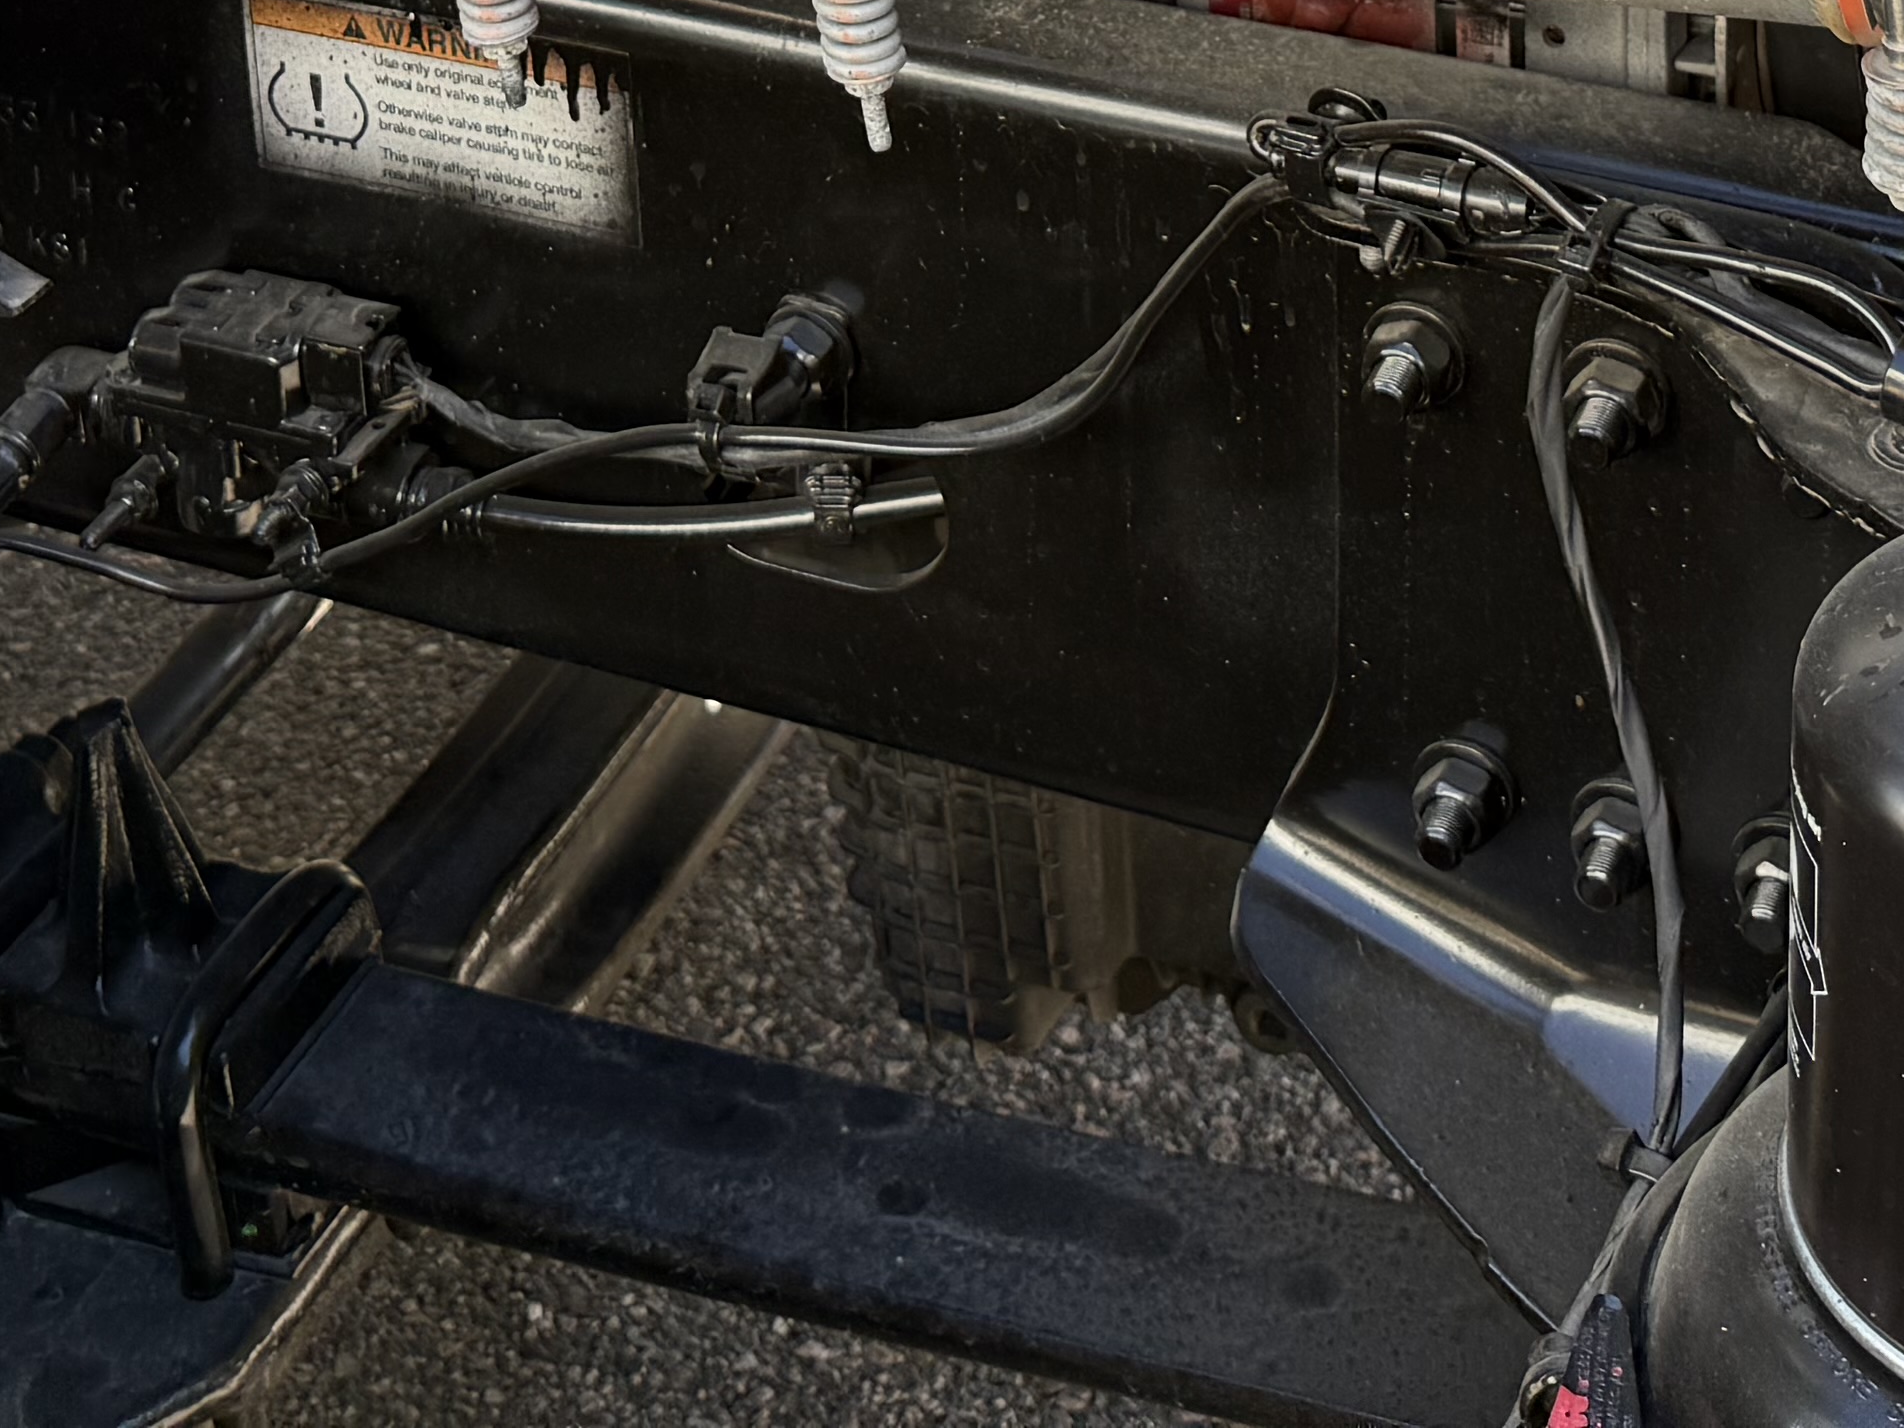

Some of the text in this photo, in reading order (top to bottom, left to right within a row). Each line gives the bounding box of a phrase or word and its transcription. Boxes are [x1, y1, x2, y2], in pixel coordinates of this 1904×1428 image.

[376, 16, 484, 61] WARN
[374, 52, 399, 70] Use
[402, 61, 430, 79] only
[434, 67, 484, 87] original
[374, 74, 412, 91] wheel
[416, 81, 441, 95] and
[446, 88, 479, 103] valve
[378, 100, 604, 157] Otherwise valve stem may contact
[378, 118, 416, 136] brake
[419, 127, 463, 146] caliper
[467, 137, 520, 160] causing
[522, 146, 545, 164] tire
[548, 152, 562, 166] to
[565, 155, 595, 173] lose
[381, 146, 582, 200] This may affect vehicle control
[382, 168, 442, 189] resulting
[444, 179, 457, 190] in
[460, 182, 497, 202] injury
[501, 192, 514, 203] or
